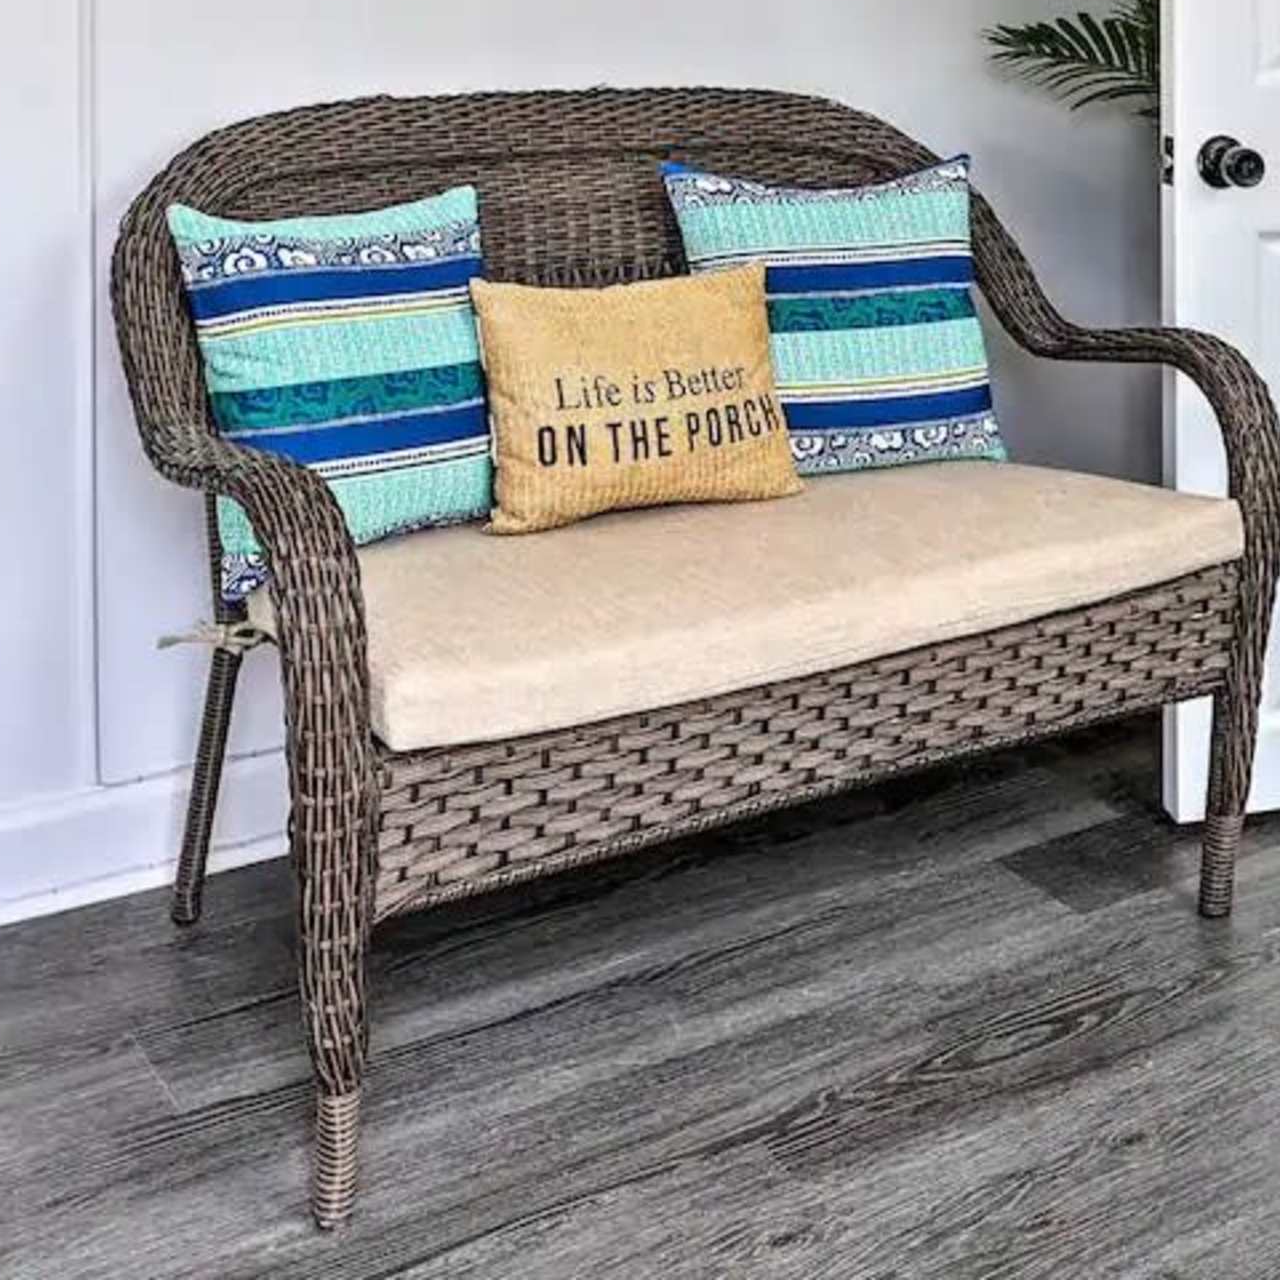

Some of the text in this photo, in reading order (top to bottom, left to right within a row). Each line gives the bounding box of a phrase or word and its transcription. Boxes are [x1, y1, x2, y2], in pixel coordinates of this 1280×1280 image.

[554, 366, 745, 410] Life is Better
[537, 392, 780, 467] ON THE PORCH
